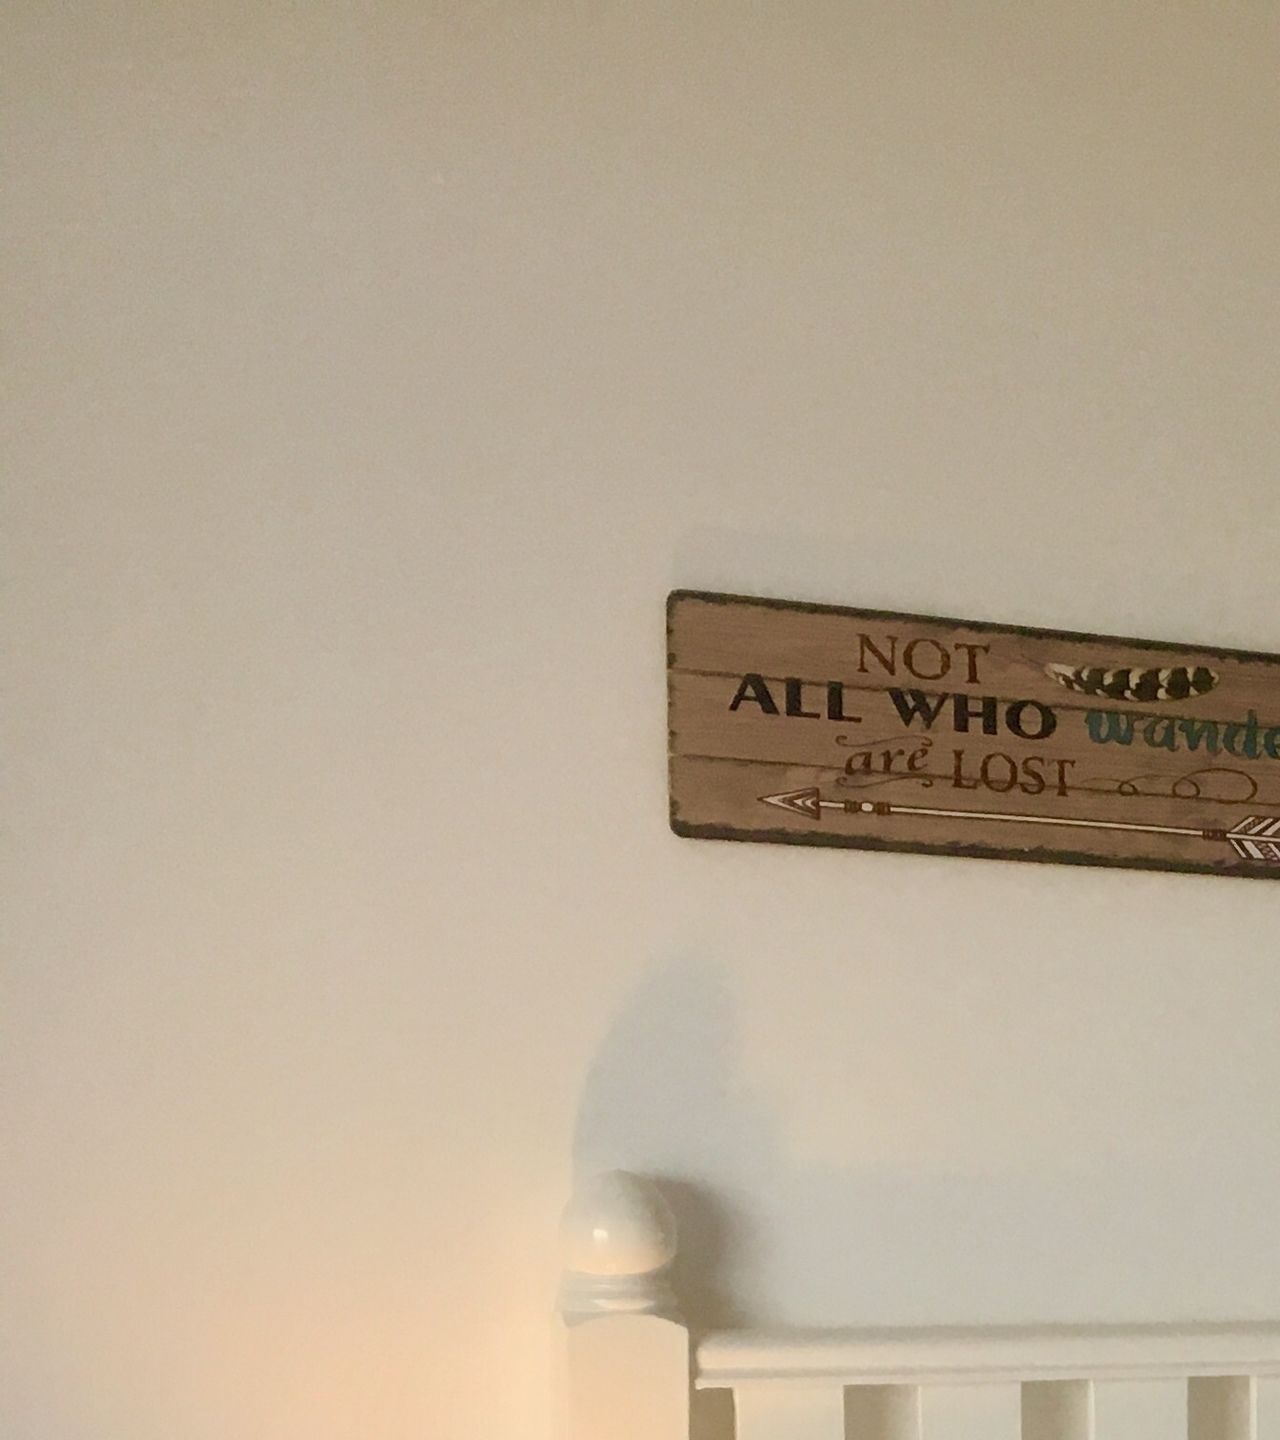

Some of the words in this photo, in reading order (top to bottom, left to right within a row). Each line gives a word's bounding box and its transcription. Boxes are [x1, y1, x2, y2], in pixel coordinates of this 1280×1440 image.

[855, 632, 991, 684] NOT
[728, 672, 862, 724] ALL
[884, 686, 1058, 740] WHO
[844, 746, 930, 776] are
[949, 749, 1077, 798] LOST
